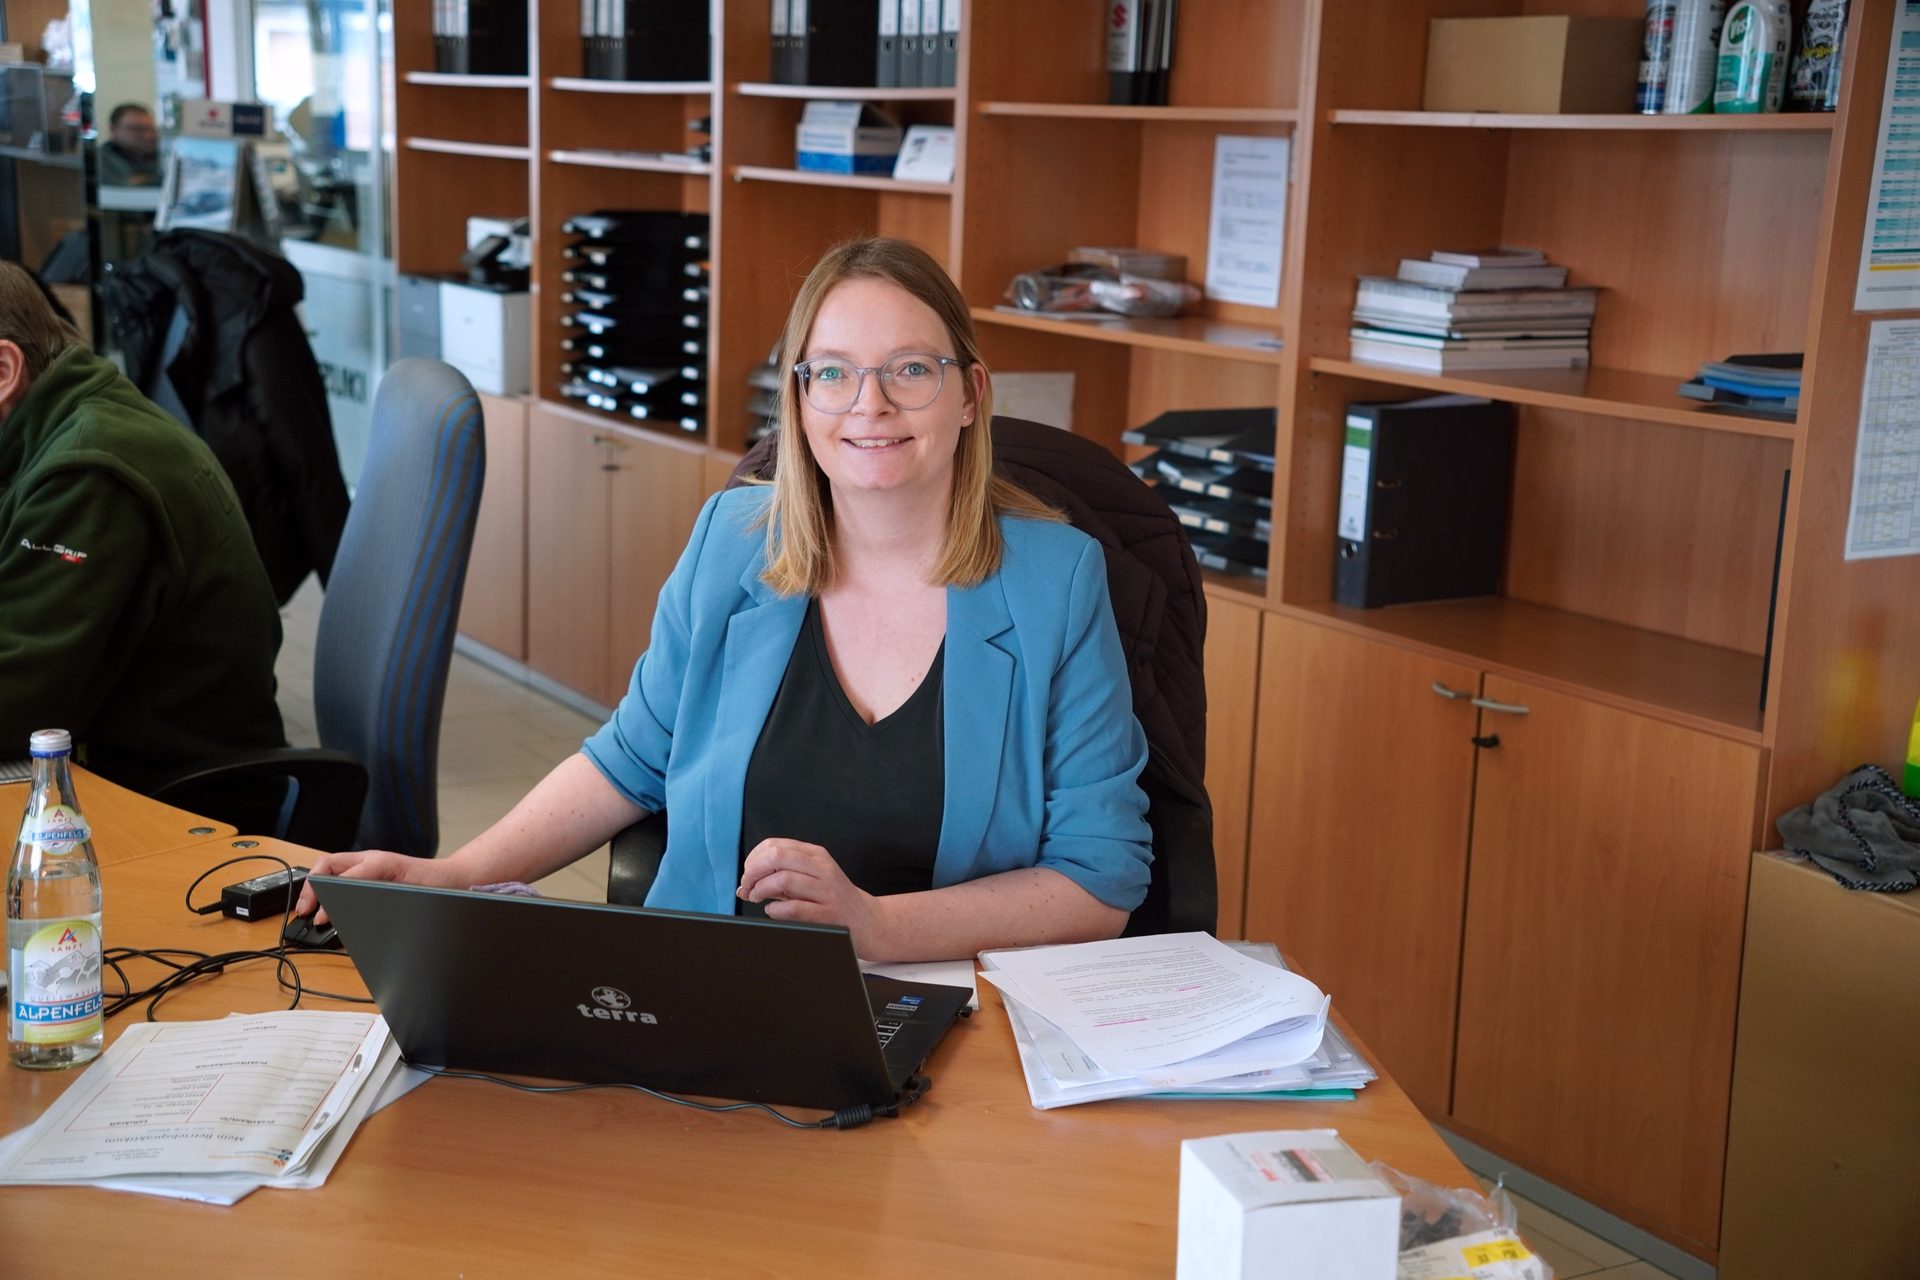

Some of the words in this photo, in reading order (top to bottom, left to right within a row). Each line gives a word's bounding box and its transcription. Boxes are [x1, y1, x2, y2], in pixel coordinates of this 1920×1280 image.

[51, 943, 83, 953] SANFT
[18, 994, 103, 1020] ALPENFELS
[576, 1003, 658, 1025] terra
